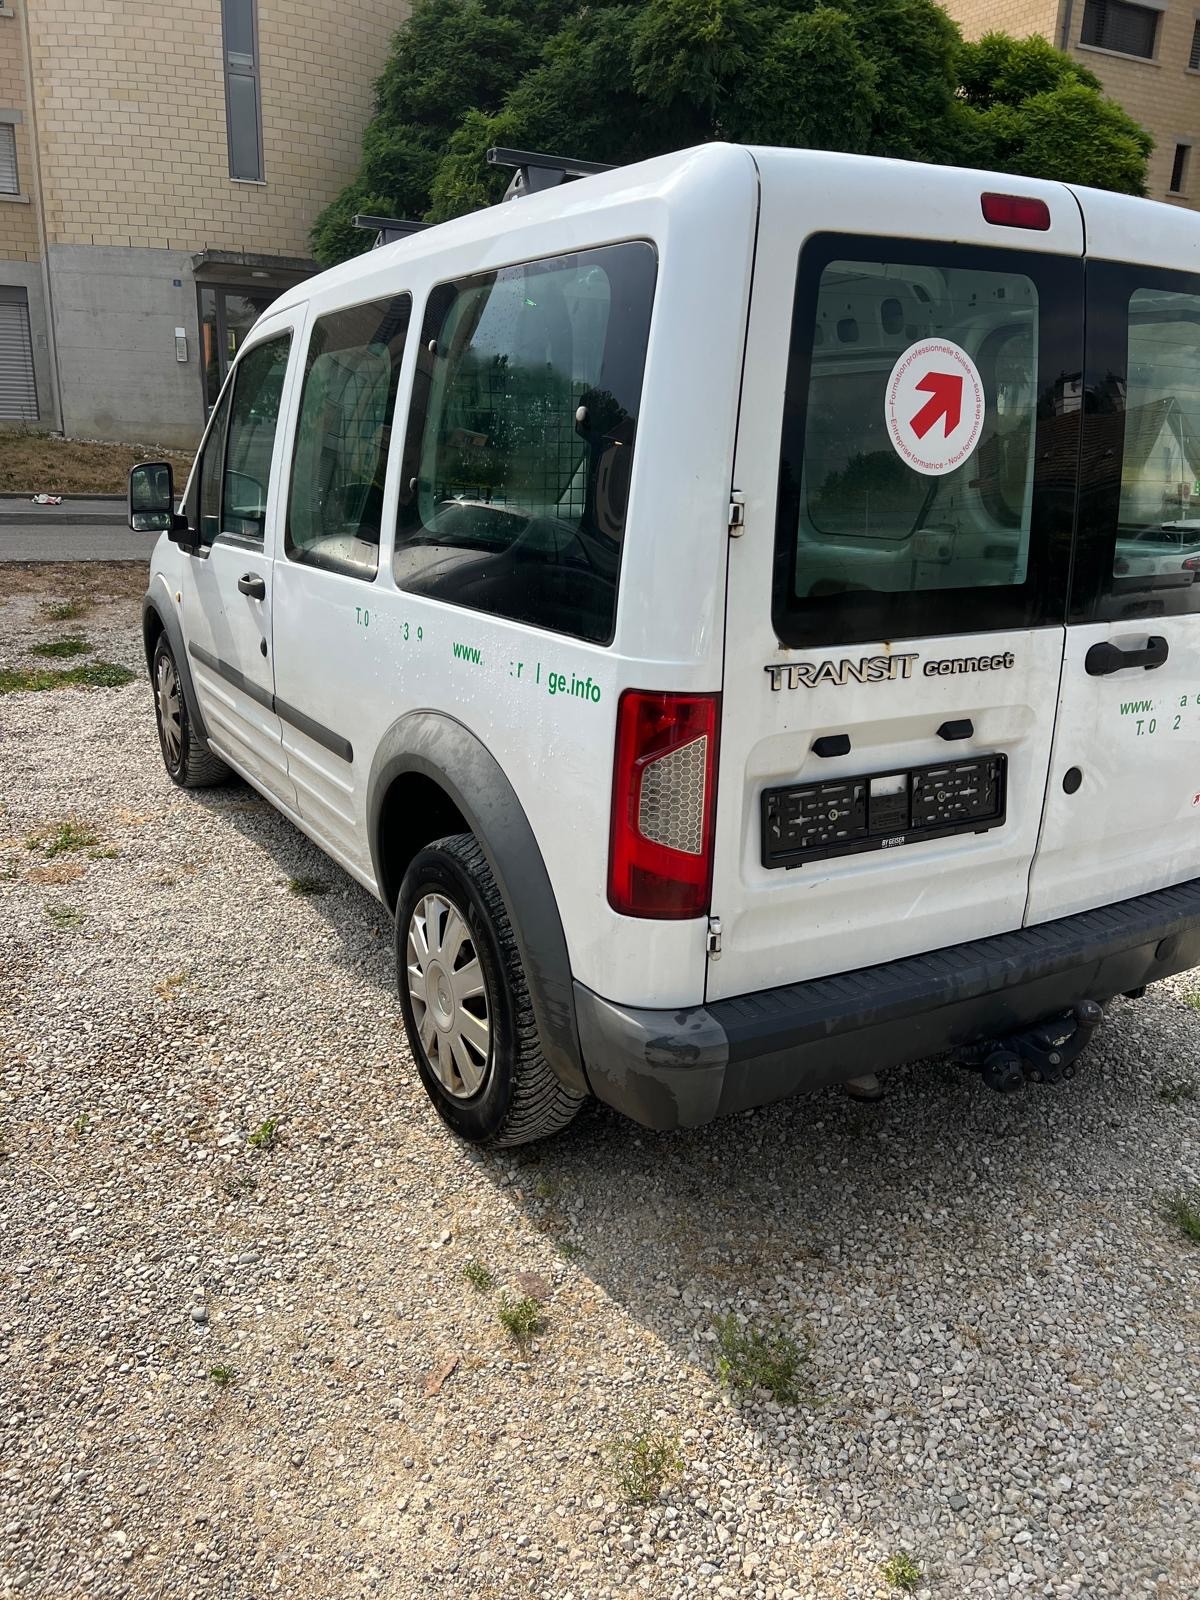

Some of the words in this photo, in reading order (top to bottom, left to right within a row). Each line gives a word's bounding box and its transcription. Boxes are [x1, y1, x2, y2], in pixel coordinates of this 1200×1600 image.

[889, 363, 908, 405] Formation
[906, 344, 954, 367] professionnelle
[953, 351, 972, 375] Suisse
[891, 418, 912, 458] Entreprise
[911, 454, 944, 469] formatrice
[948, 450, 965, 466] Nous
[962, 421, 980, 453] formons
[973, 383, 982, 404] pros
[764, 653, 919, 691] TRANSIT
[923, 651, 1015, 676] connect
